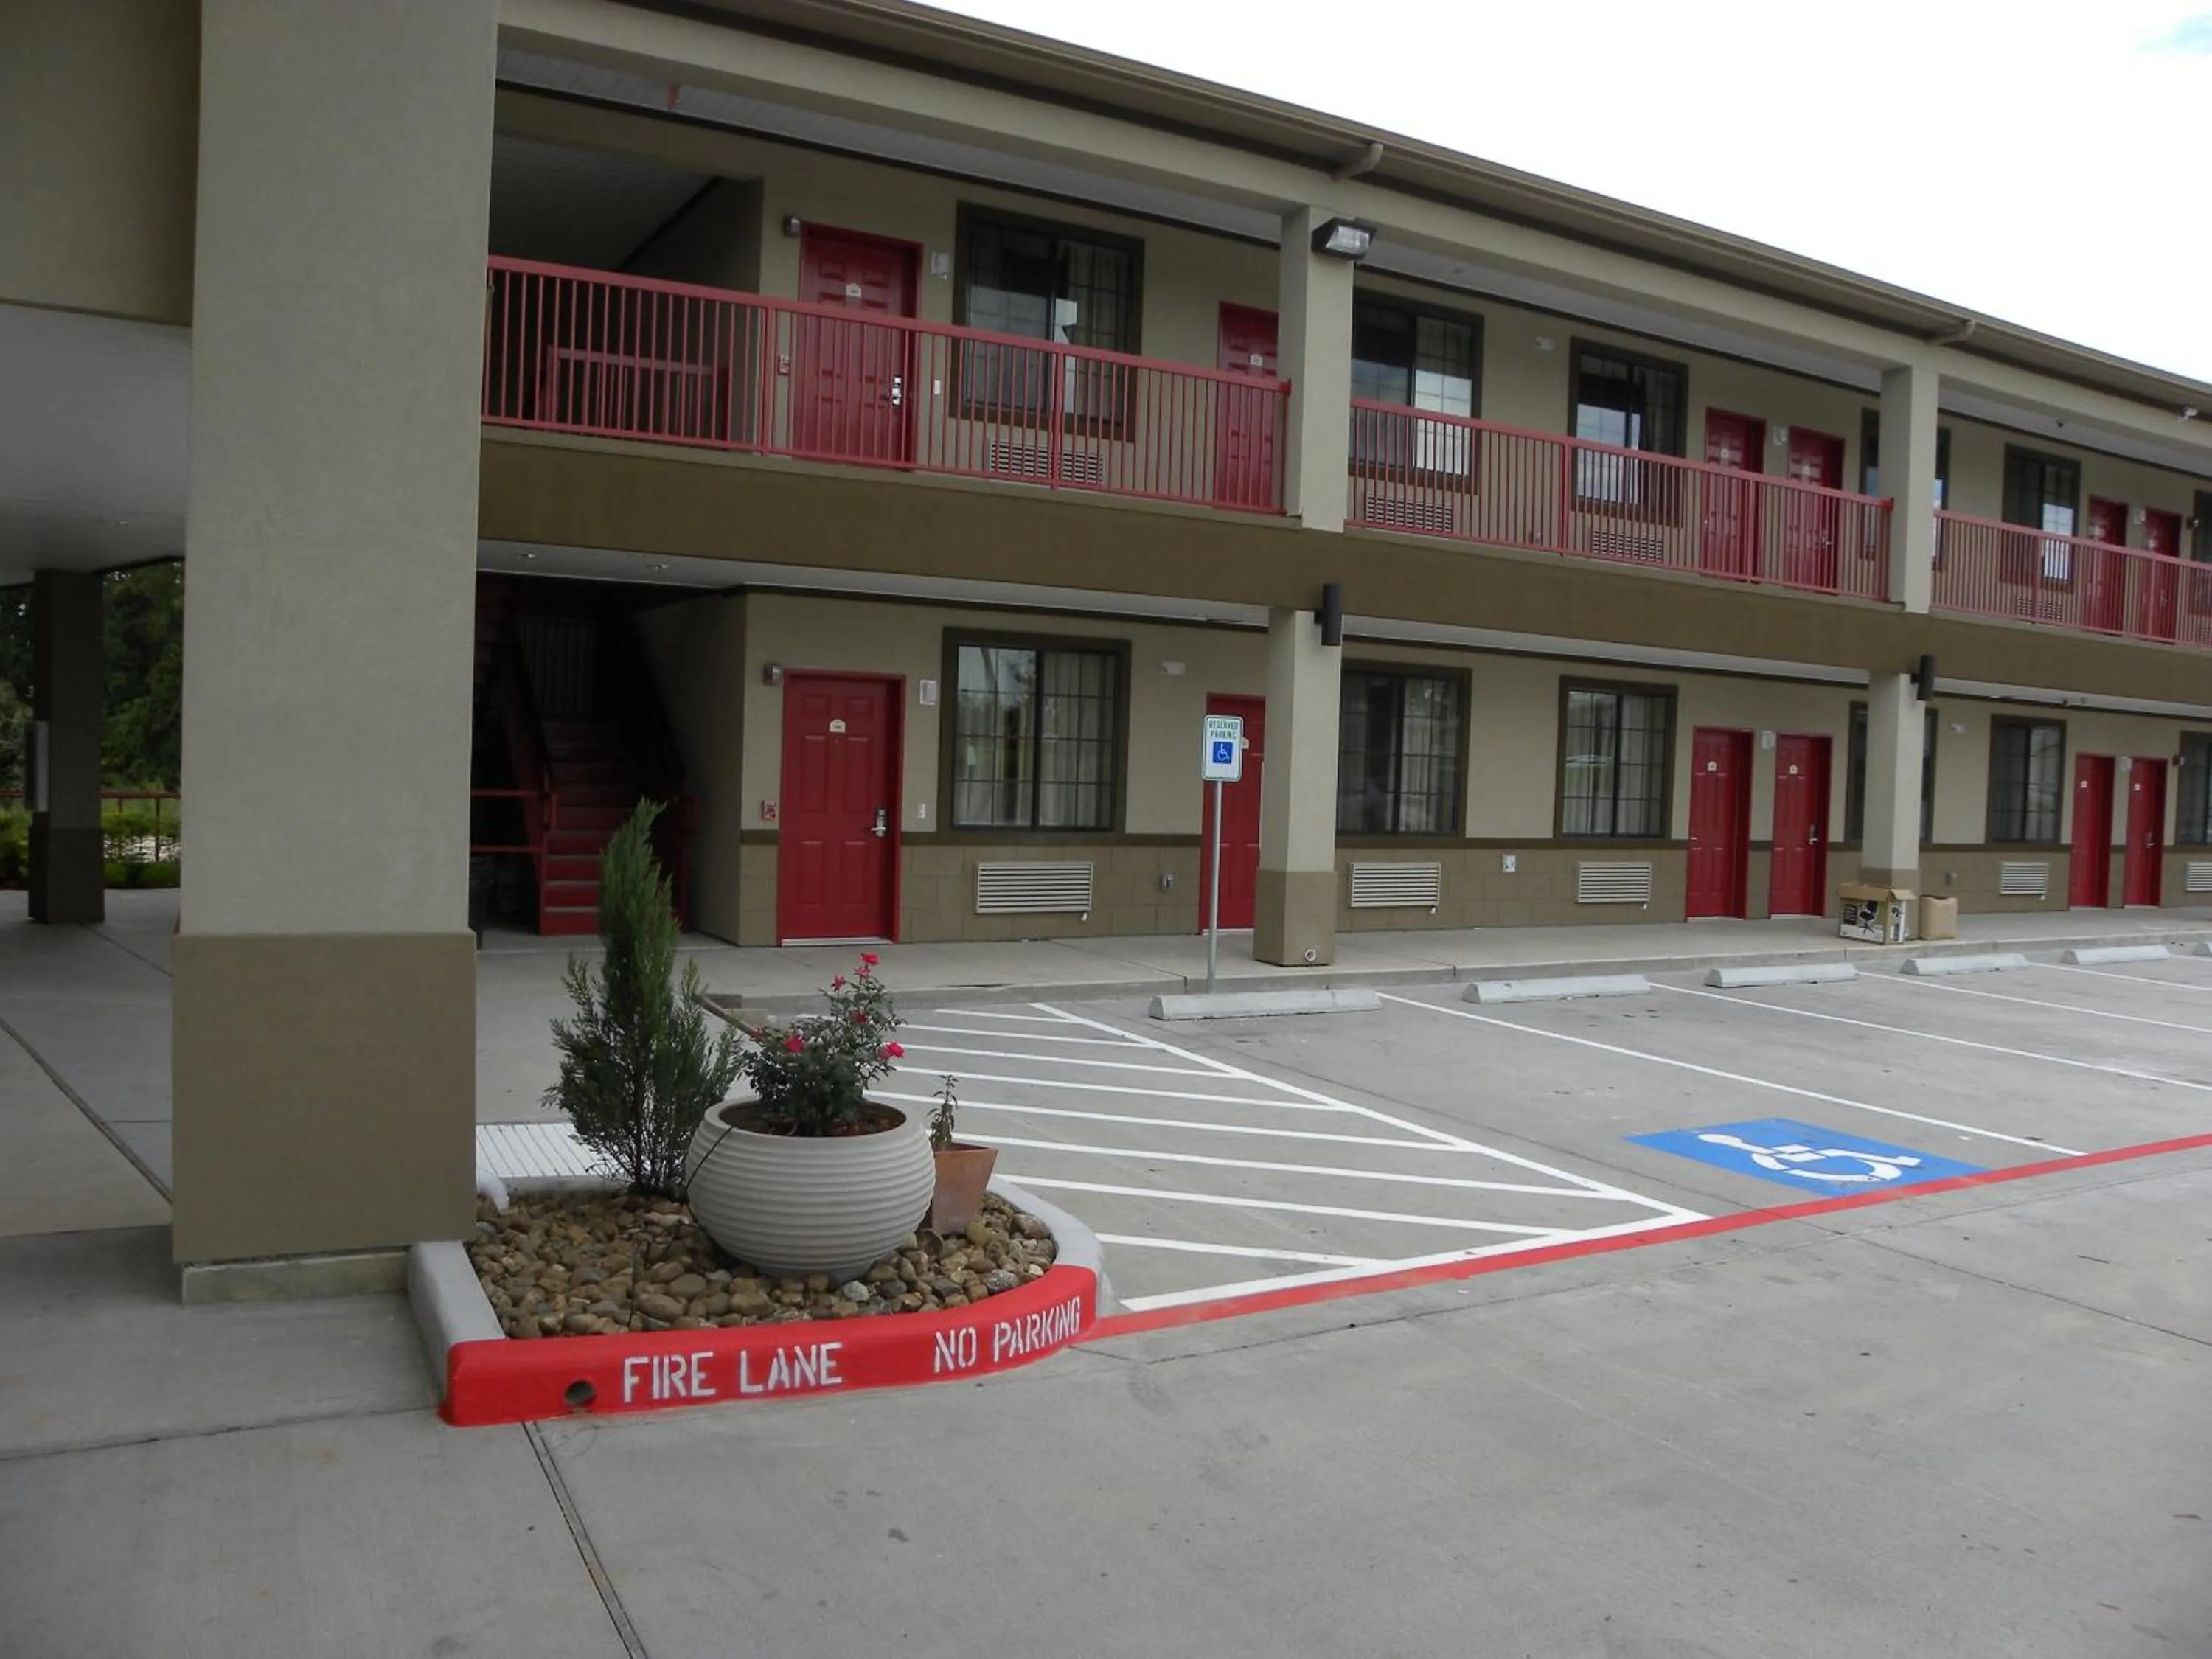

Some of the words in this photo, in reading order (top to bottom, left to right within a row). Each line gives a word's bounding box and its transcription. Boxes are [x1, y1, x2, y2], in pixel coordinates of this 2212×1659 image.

[1209, 720, 1239, 730] RESERVED
[1210, 730, 1237, 740] PARKING
[933, 1326, 976, 1373] NO
[993, 1295, 1081, 1363] PARKING
[624, 1351, 715, 1402] FIRE
[740, 1342, 843, 1393] LANE
